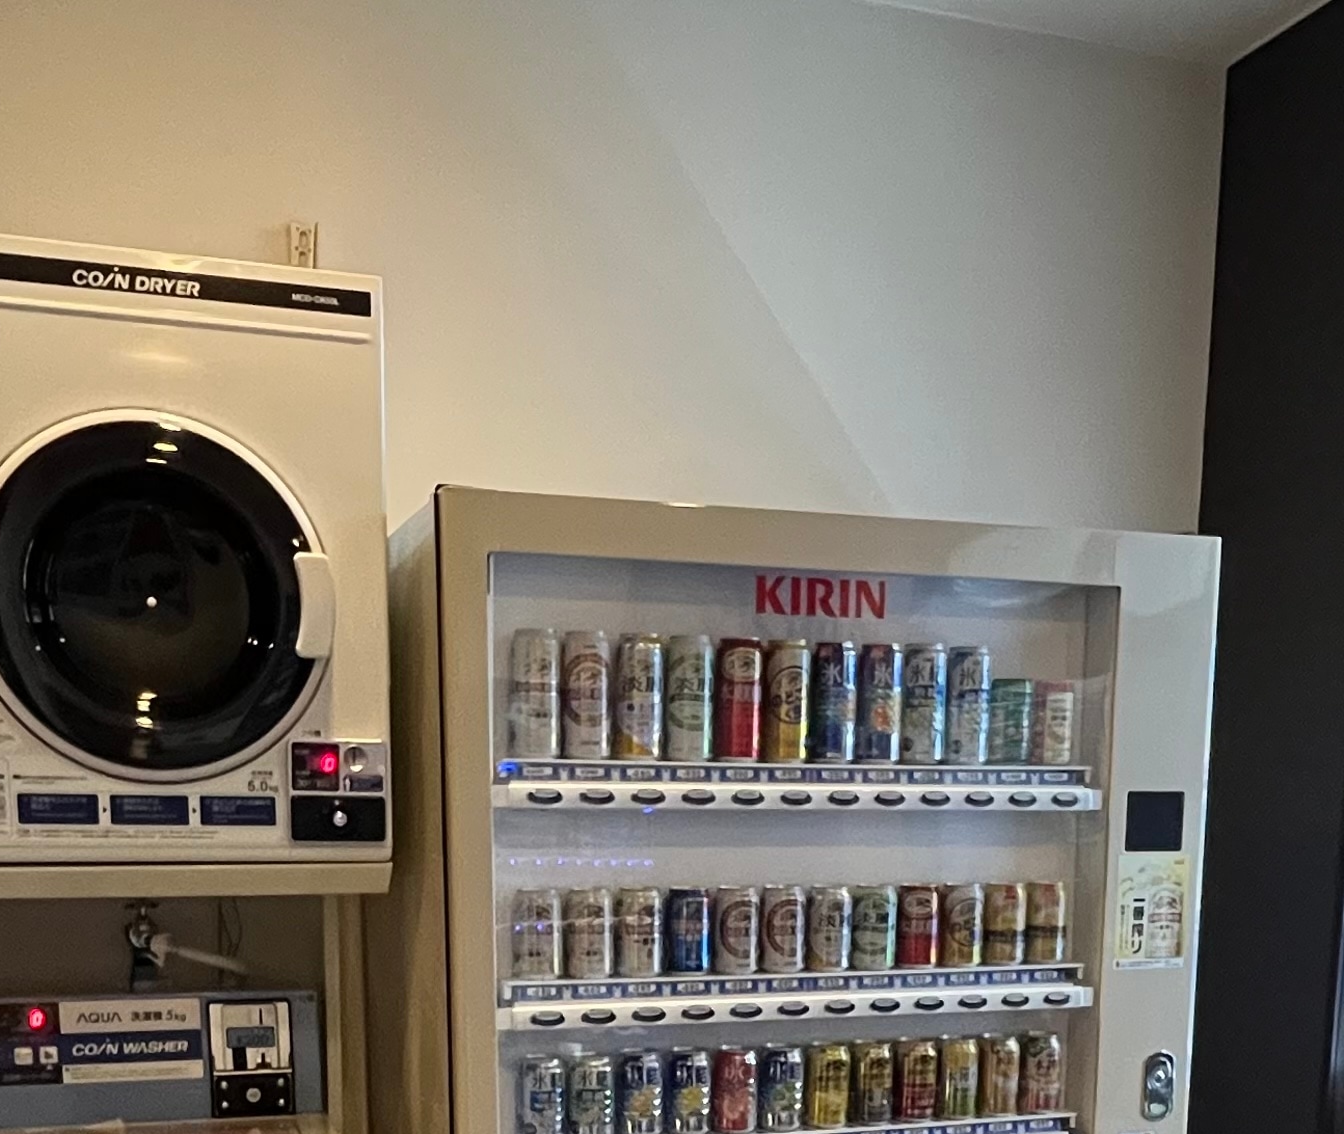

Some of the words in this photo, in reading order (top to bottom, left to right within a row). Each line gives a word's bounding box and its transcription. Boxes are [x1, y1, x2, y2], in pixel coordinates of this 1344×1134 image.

[135, 274, 201, 298] DRYER
[755, 575, 886, 620] KIRIN
[76, 1012, 123, 1024] AQUA
[122, 1040, 189, 1055] WASHER
